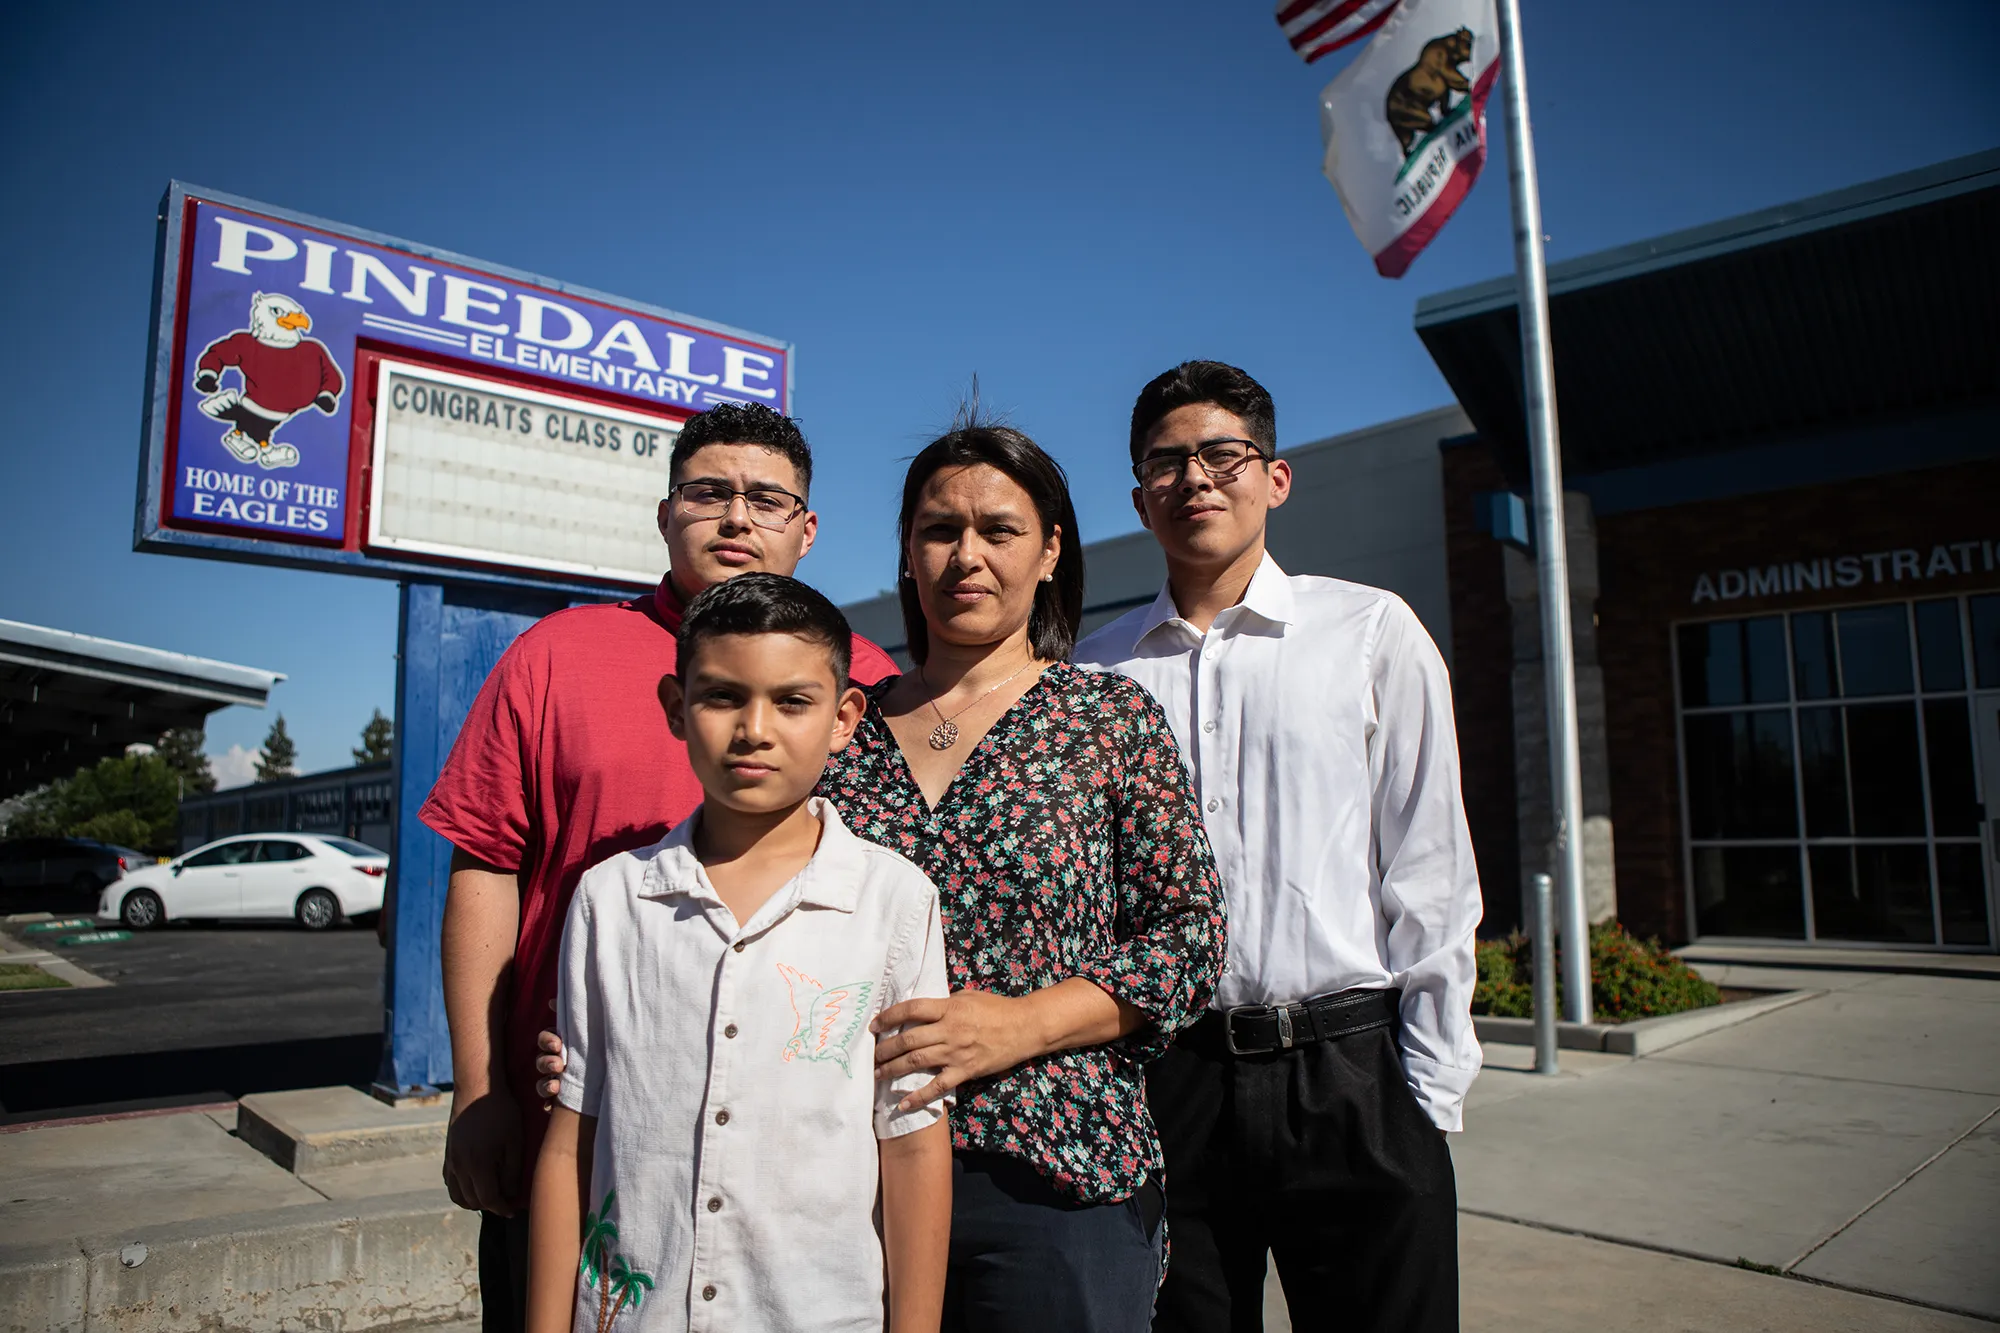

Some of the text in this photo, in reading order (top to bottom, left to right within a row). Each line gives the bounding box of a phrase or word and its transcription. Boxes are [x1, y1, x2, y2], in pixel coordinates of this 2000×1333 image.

[212, 215, 777, 400] PINEDALE
[470, 332, 700, 404] ELEMENTARY
[392, 383, 659, 457] CONGRATS CLASS OF
[184, 466, 339, 509] HOME OF THE
[192, 492, 329, 532] EAGLES
[1690, 538, 2000, 604] ADMINISTRATI
